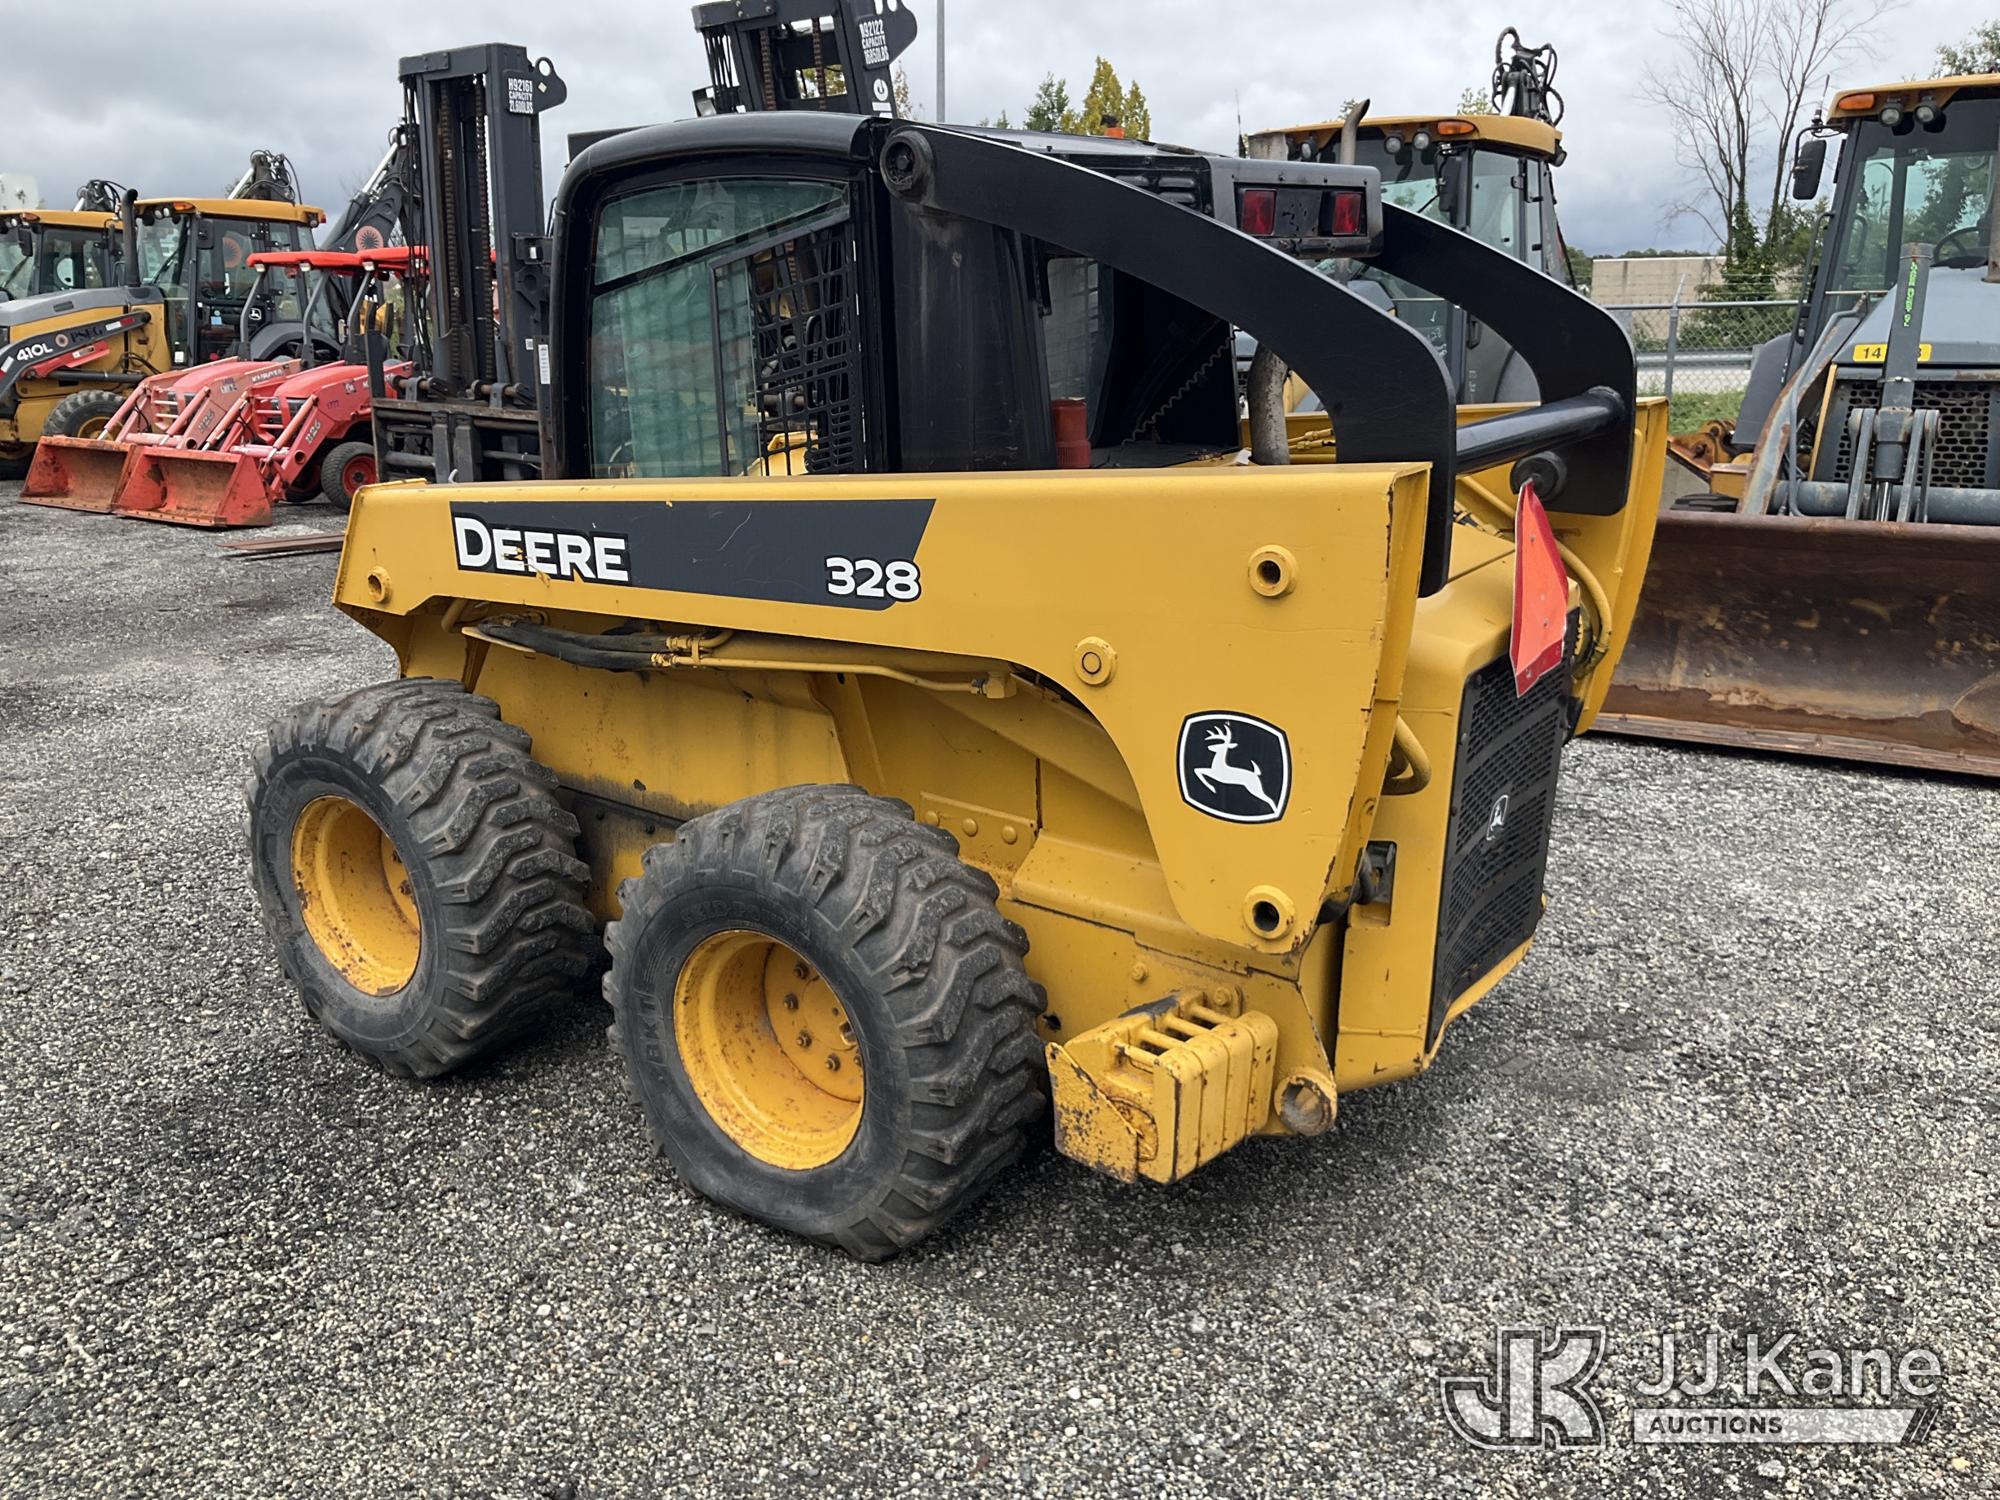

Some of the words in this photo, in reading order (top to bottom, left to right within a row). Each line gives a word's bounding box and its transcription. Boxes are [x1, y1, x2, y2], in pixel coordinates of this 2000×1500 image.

[862, 35, 886, 49] CAPACITY
[508, 78, 533, 92] H92161
[509, 91, 533, 101] CAPACITY
[17, 343, 53, 361] 410L
[251, 369, 283, 382] KUBOTA
[455, 516, 629, 582] DEERE
[826, 557, 921, 600] 328
